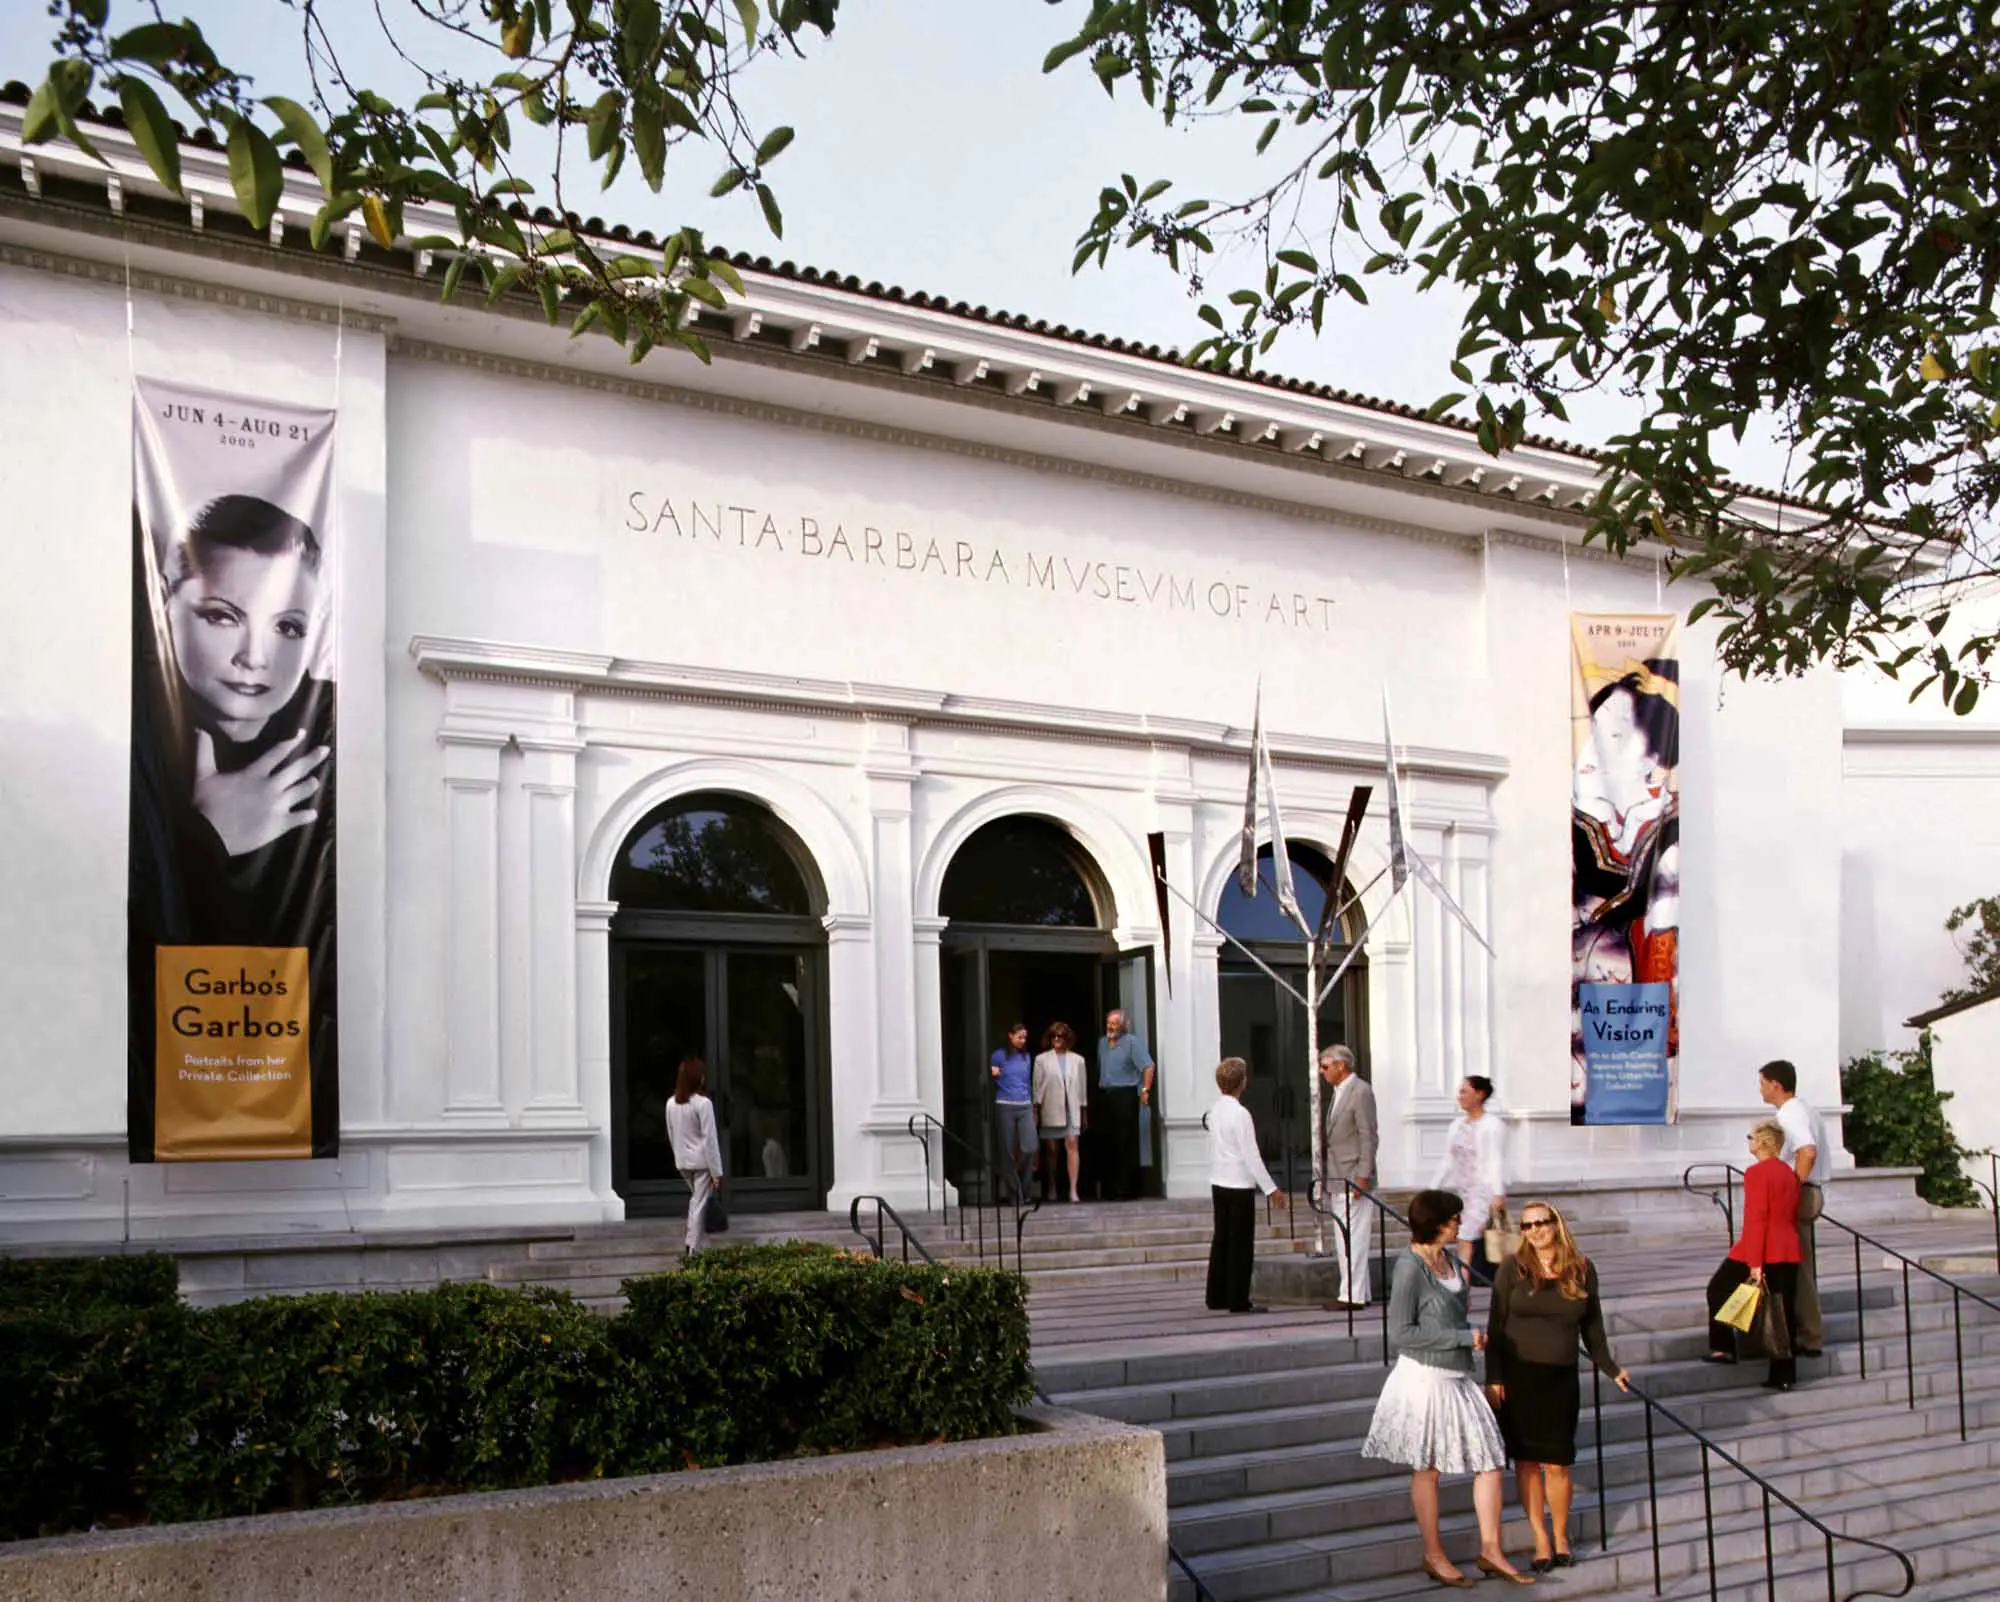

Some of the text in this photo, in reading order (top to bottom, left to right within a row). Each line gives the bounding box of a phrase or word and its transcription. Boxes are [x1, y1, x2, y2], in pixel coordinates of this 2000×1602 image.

[163, 404, 205, 424] JUN
[289, 425, 310, 441] 21
[219, 434, 255, 448] 2005
[626, 491, 1336, 631] SANTA BARBARA MVSEVM OF ART
[1588, 624, 1611, 636] APR
[185, 968, 288, 996] Garbo's
[1583, 999, 1667, 1018] An Enduring
[172, 1005, 301, 1038] Garbos
[1592, 1020, 1655, 1041] Vision
[184, 1053, 287, 1067] Portraits from her
[178, 1068, 292, 1082] Private Collection
